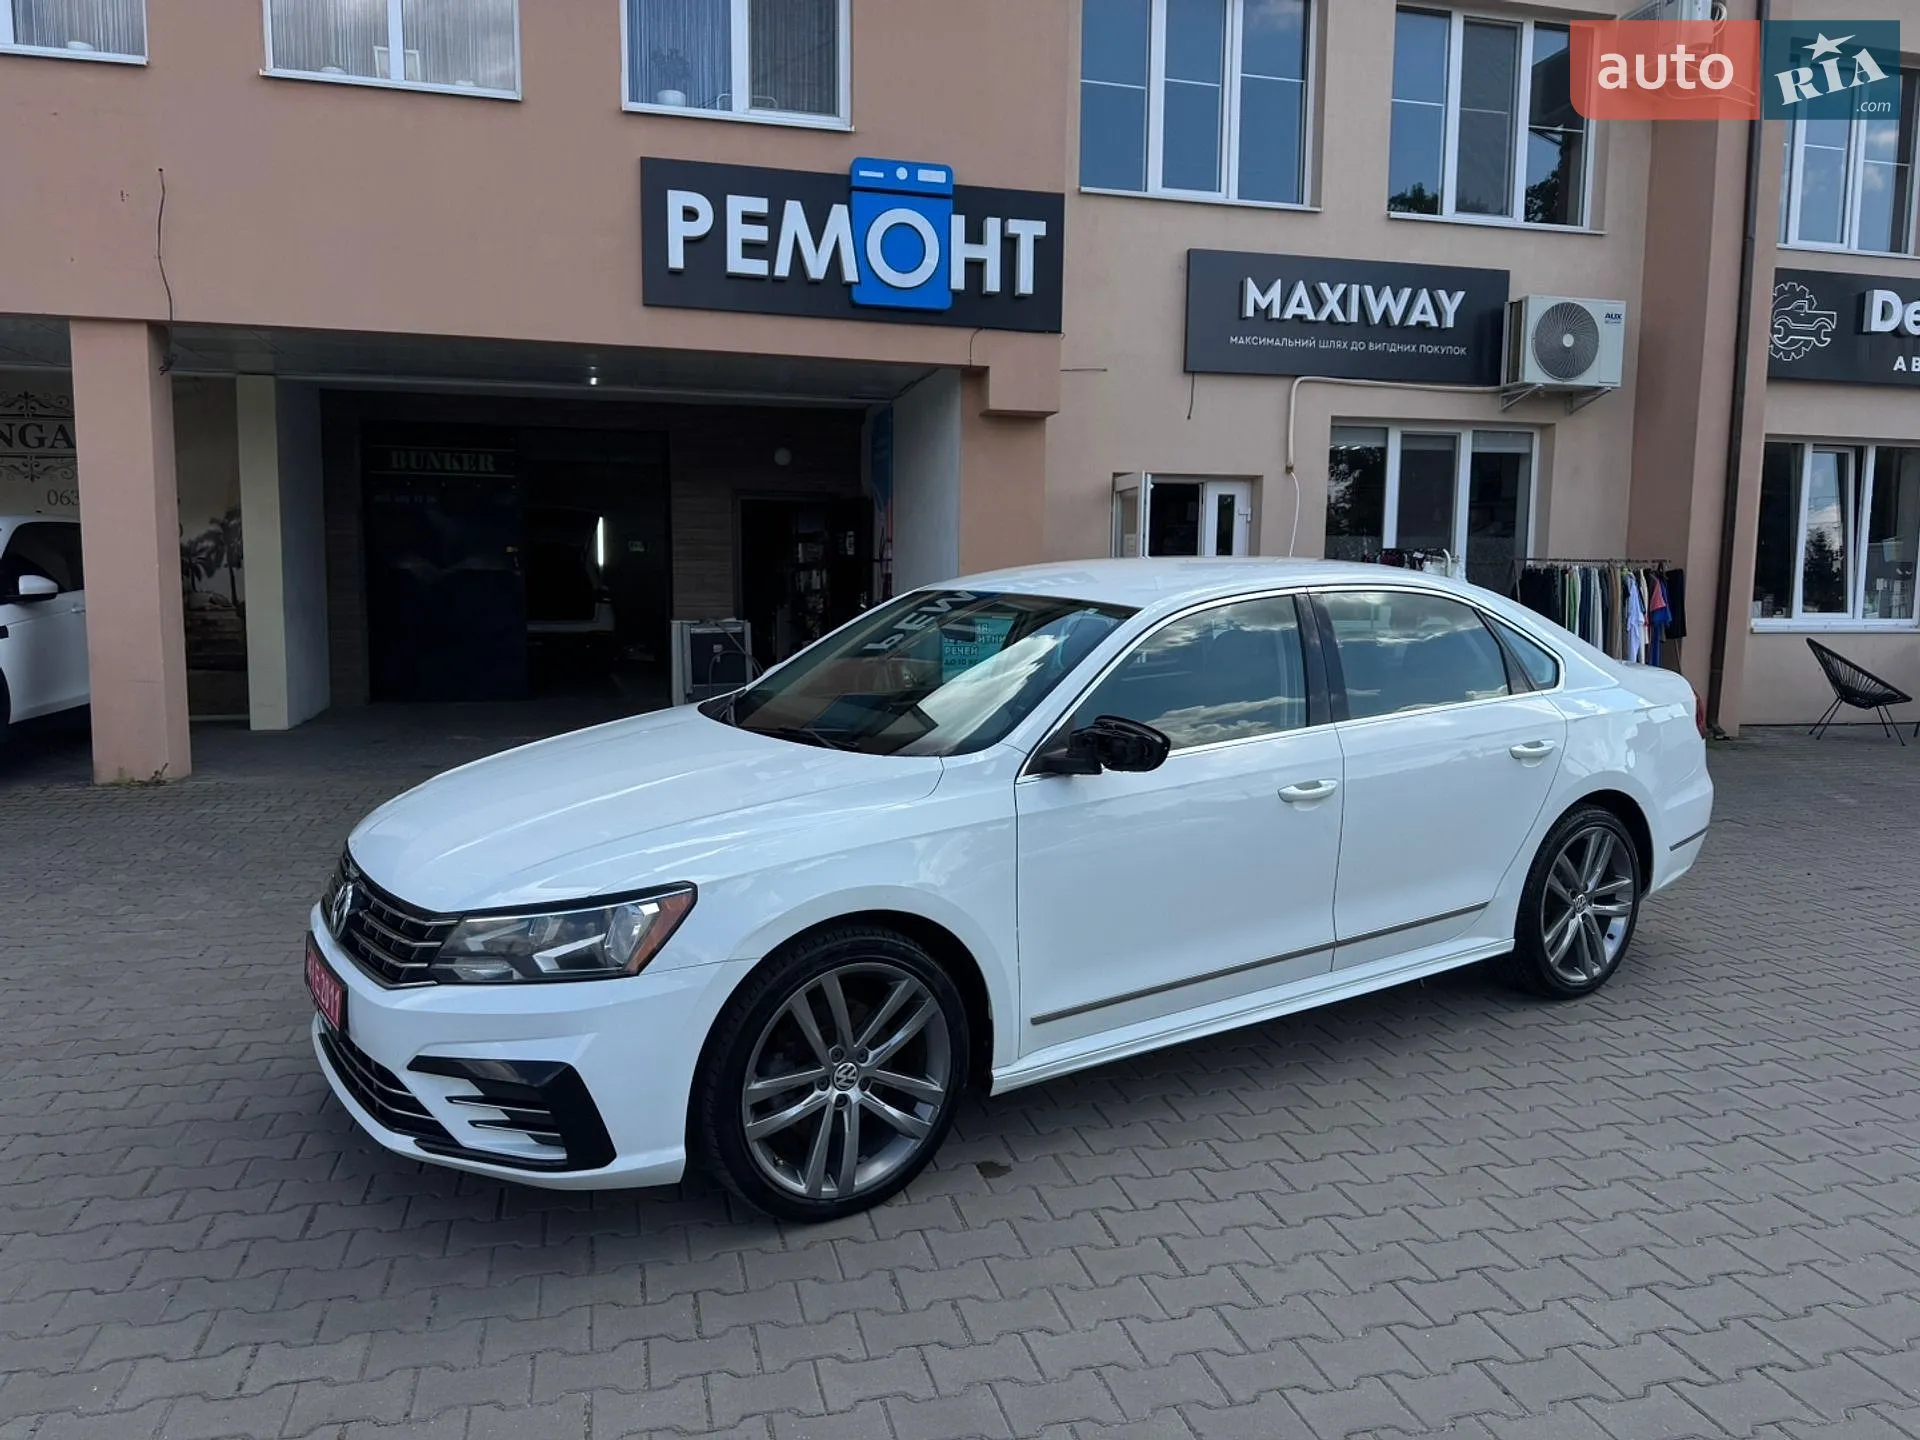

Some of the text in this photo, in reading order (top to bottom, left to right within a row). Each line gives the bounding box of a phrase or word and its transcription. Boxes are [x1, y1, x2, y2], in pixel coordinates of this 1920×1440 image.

[666, 189, 1047, 297] РЕМОНТ
[1242, 276, 1466, 329] MAXIWAY
[1229, 334, 1467, 356] МАКСИМАЛЬНИЙ ШЛЯХ ДО ВИГІДНИХ ПОКУПОК
[389, 450, 497, 472] BUNKER
